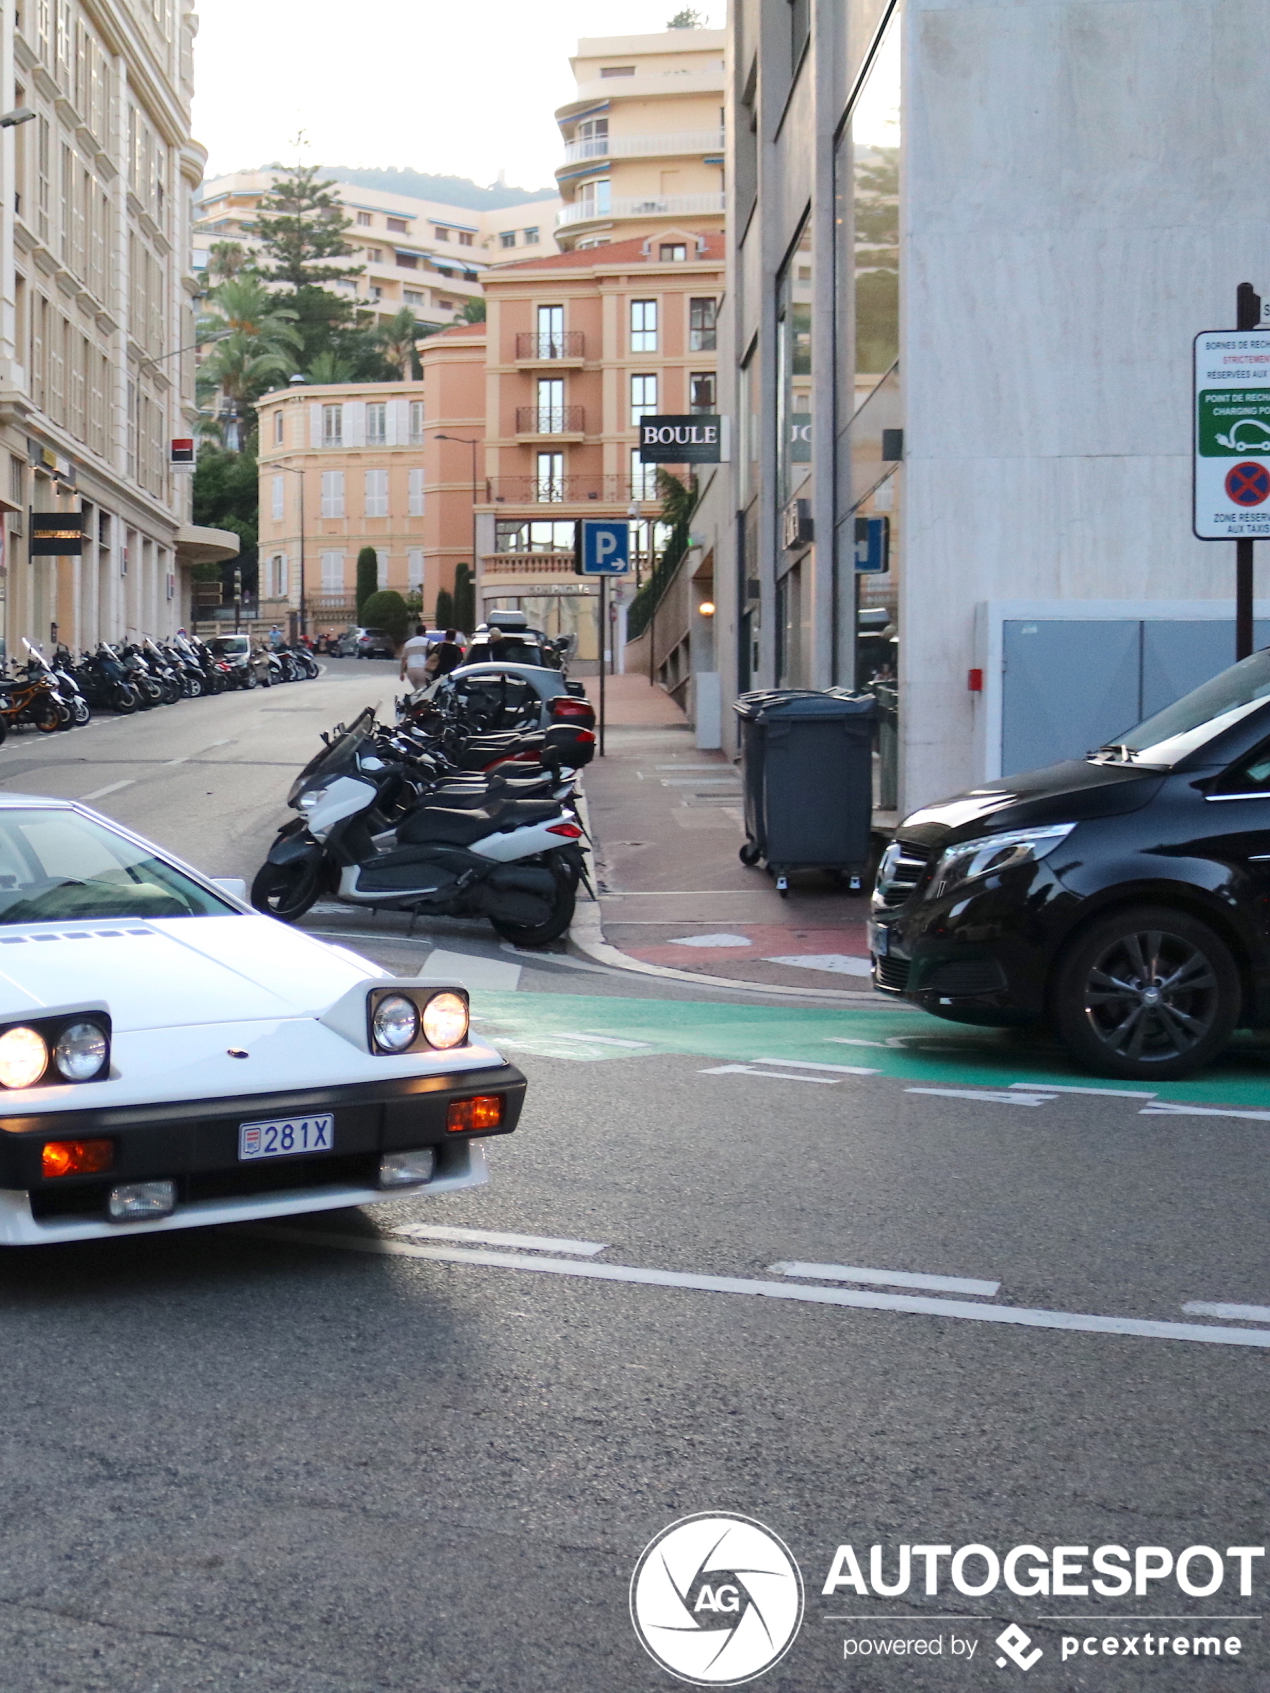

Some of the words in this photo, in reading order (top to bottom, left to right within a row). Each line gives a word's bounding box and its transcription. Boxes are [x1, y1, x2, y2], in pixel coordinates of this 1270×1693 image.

[1206, 341, 1236, 350] BORNES
[1238, 341, 1248, 350] DE
[1251, 340, 1270, 349] RECH
[1223, 354, 1270, 365] STRICTEMEN
[1252, 369, 1267, 378] AUX
[1205, 394, 1230, 403] POINT
[1232, 394, 1244, 403] DE
[1245, 393, 1270, 402] RECH
[1213, 407, 1258, 416] CHARGING
[643, 426, 719, 445] BOULE
[1214, 513, 1236, 523] ZONE
[1227, 525, 1244, 533] AUX
[596, 531, 617, 564] P
[264, 1120, 327, 1153] 281X
